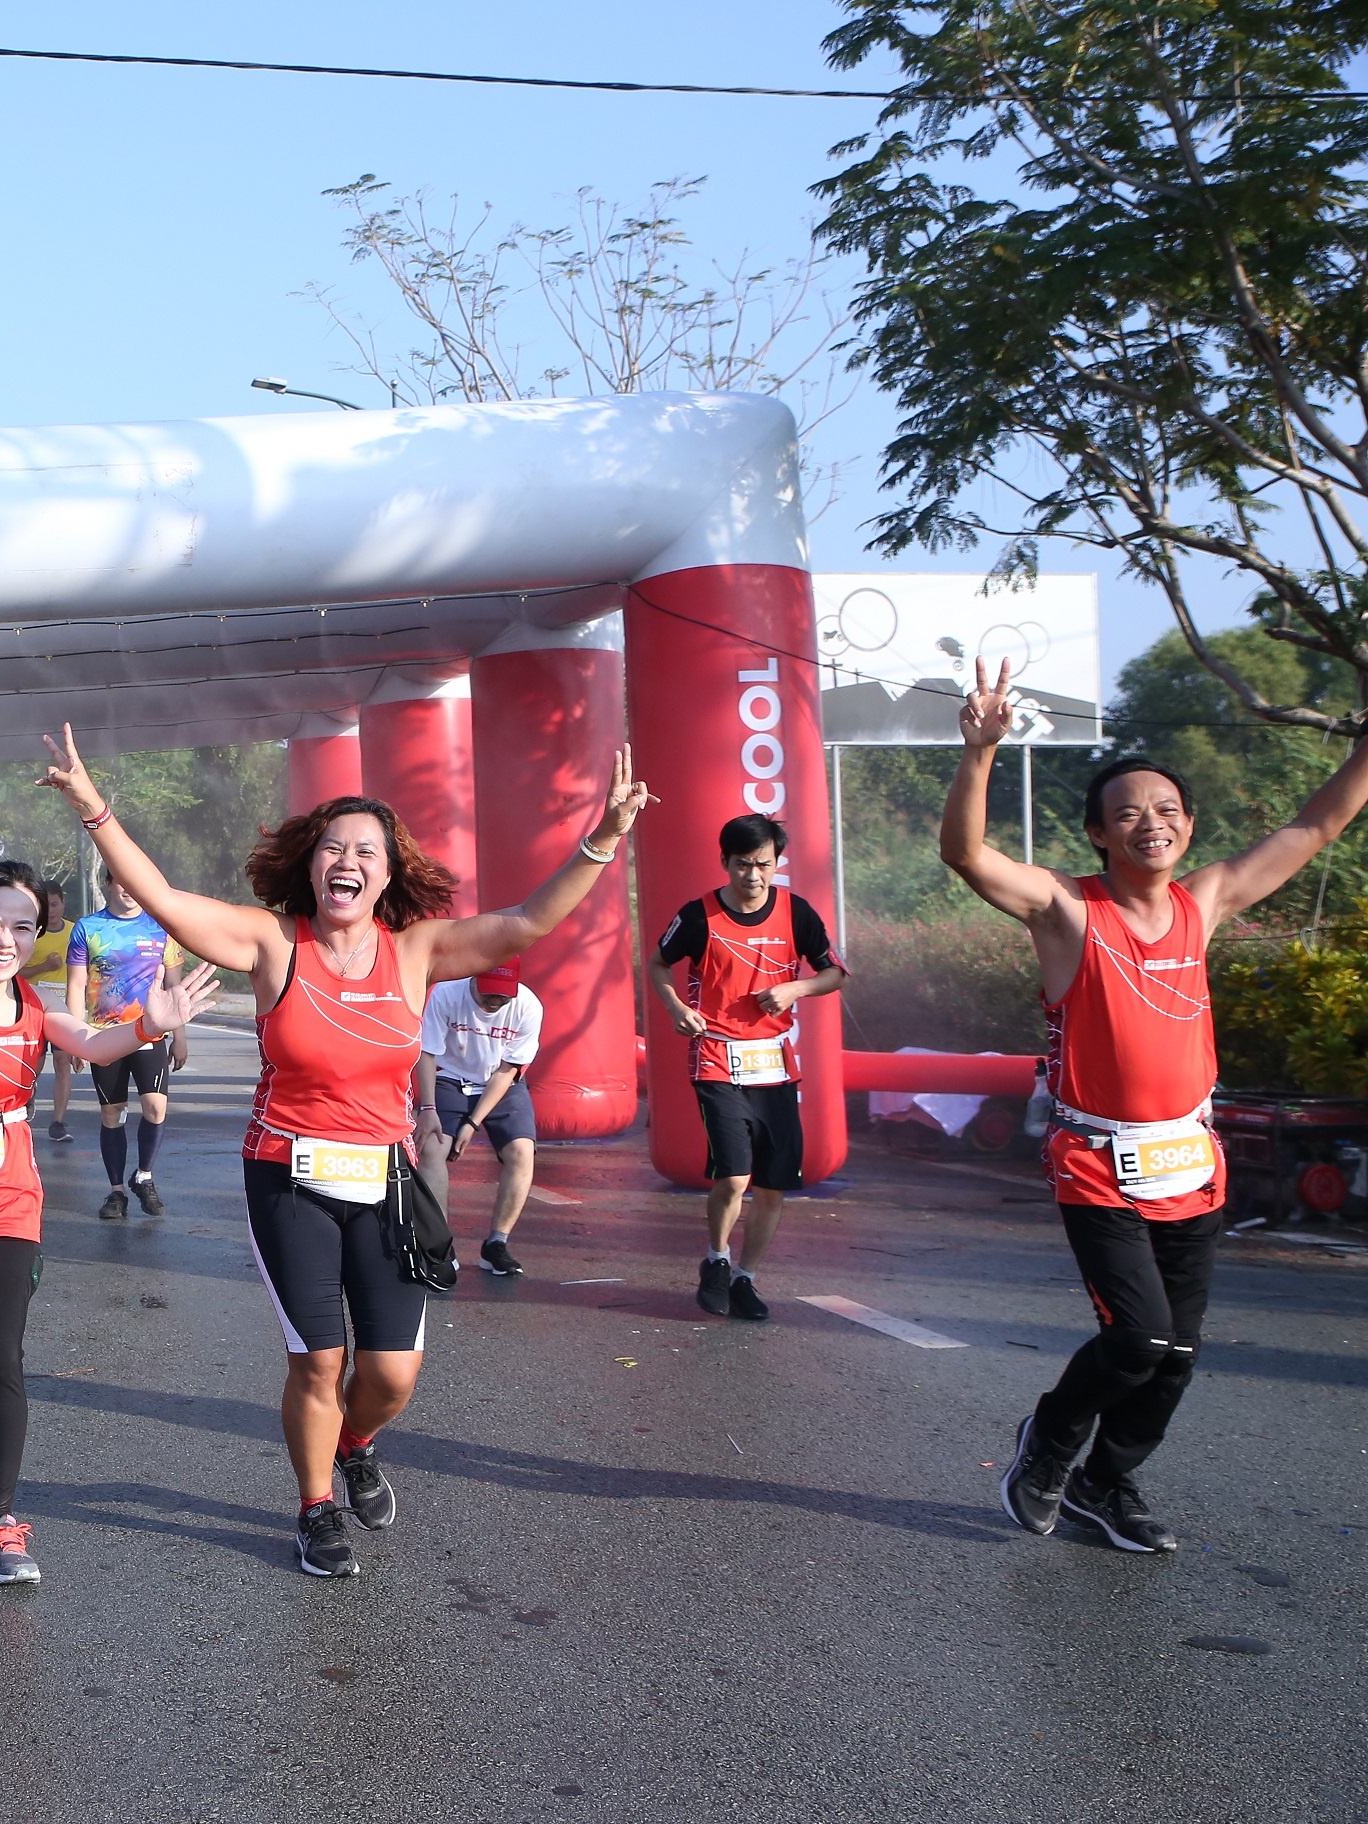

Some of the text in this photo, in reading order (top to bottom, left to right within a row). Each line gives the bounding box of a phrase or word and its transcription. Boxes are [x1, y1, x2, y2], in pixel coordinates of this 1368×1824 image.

[738, 656, 786, 817] COOL
[744, 1054, 782, 1068] 13011
[296, 1155, 379, 1179] E 3963
[1119, 1142, 1206, 1173] E 3964
